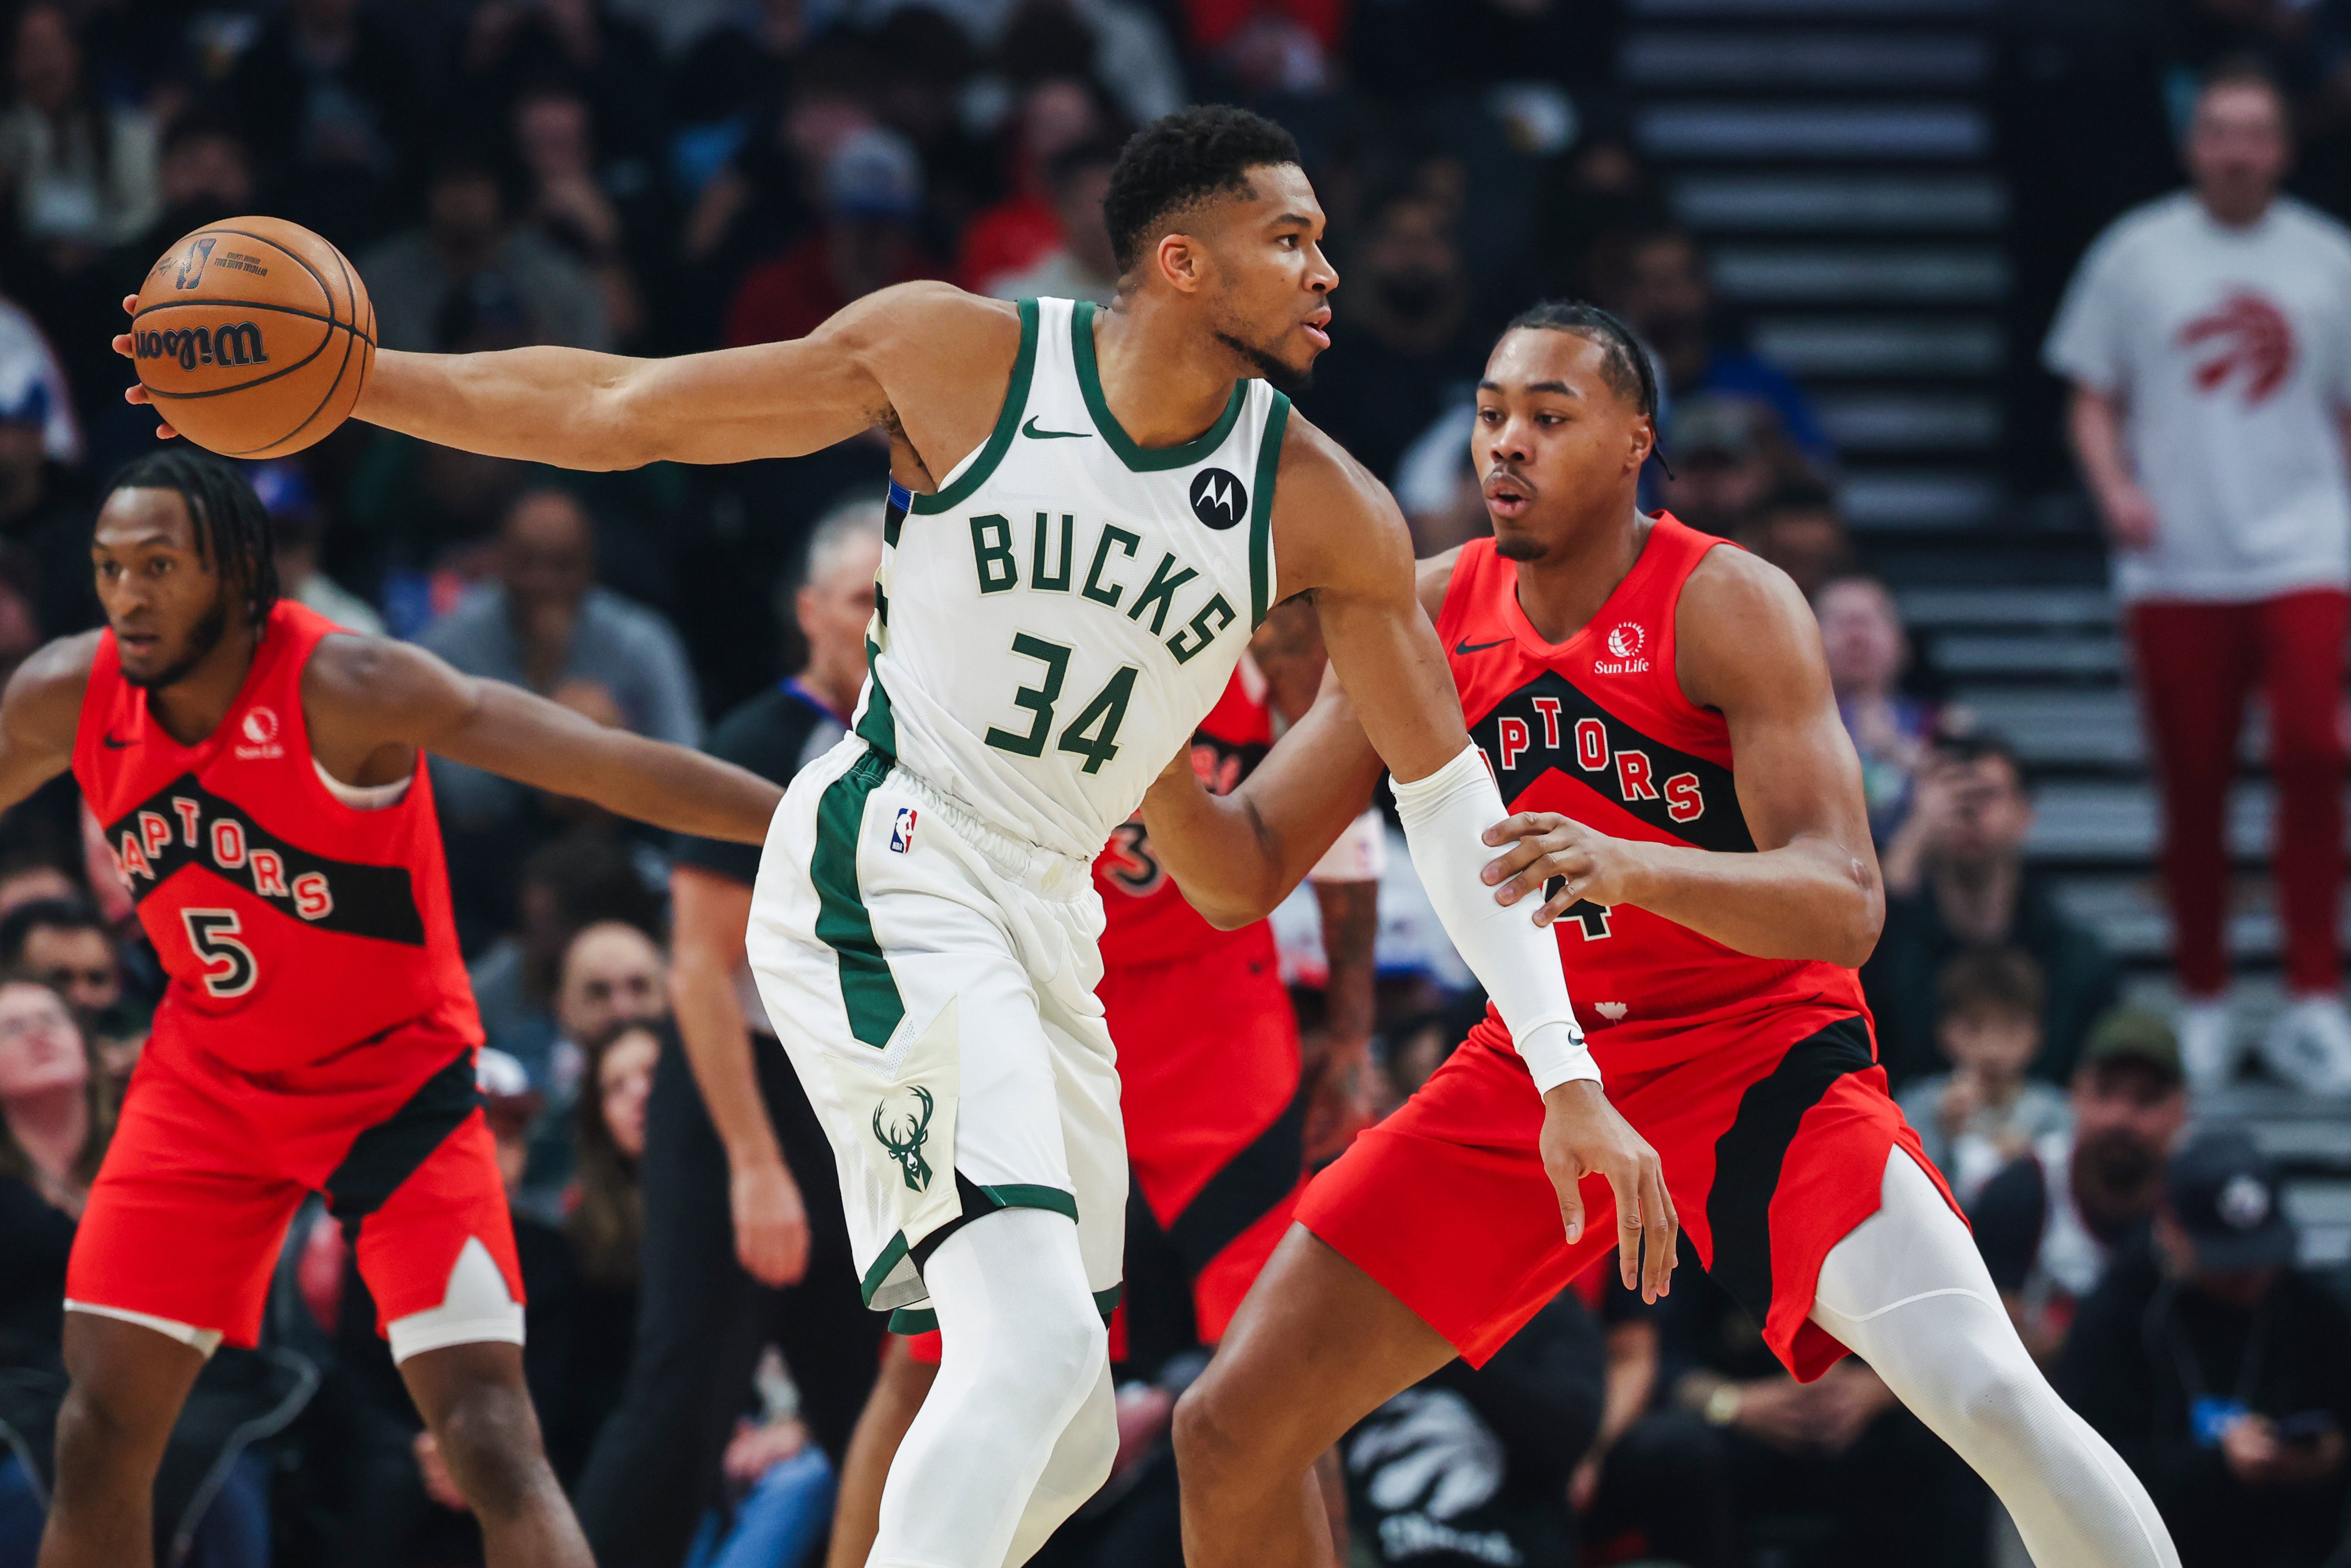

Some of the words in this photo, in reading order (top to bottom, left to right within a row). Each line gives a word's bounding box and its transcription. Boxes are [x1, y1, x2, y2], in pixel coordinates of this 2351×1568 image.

[243, 263, 268, 276] OFFICIAL
[134, 322, 269, 372] Wilson
[967, 509, 1240, 668] BUCKS
[981, 627, 1143, 777] 34
[1594, 660, 1622, 674] Sun
[1625, 657, 1649, 673] Life
[1478, 696, 1705, 823] PTORS
[116, 796, 333, 920] APTORS
[892, 841, 903, 851] NBA
[181, 908, 258, 998] 5
